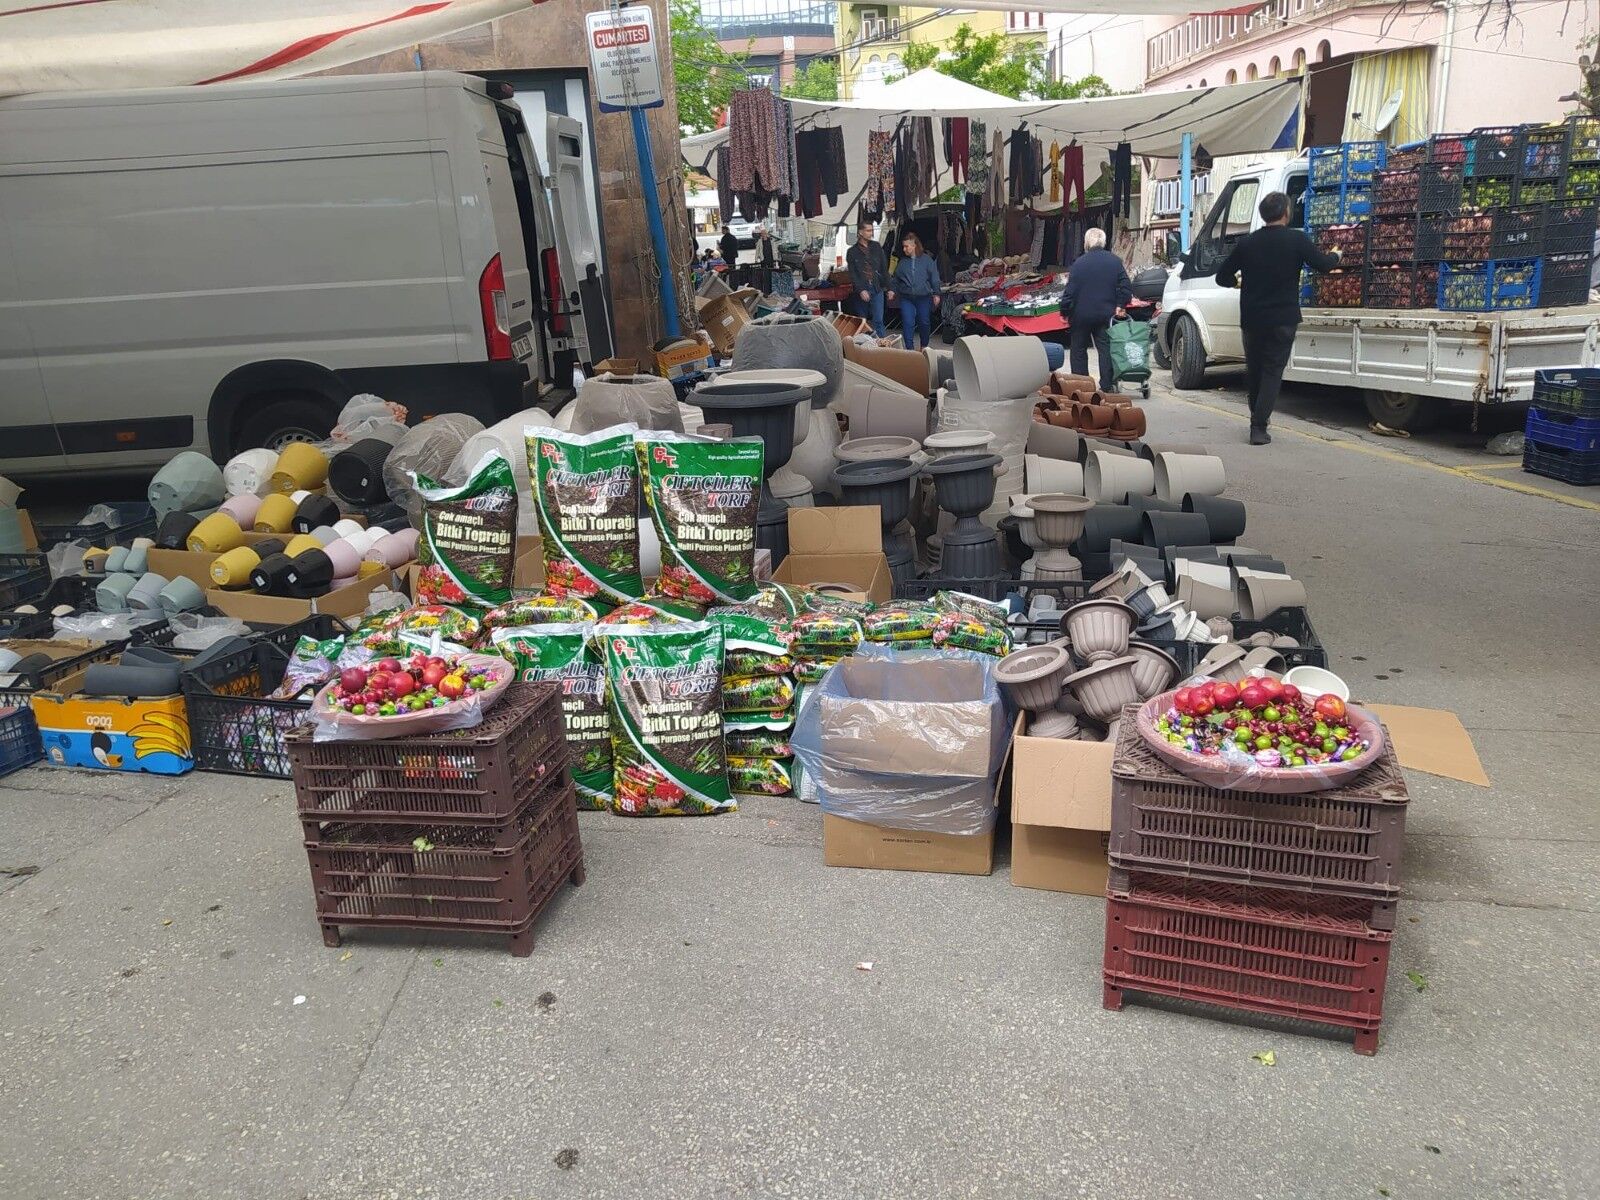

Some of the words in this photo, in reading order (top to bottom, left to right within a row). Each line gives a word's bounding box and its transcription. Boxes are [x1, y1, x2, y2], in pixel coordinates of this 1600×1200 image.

[596, 26, 648, 46] CUMARTESİ
[662, 472, 752, 494] ÇİFTÇİLER
[707, 492, 752, 507] TORF
[438, 511, 454, 522] Çok
[454, 514, 484, 526] amaçlı
[561, 516, 587, 531] Bitki
[589, 514, 635, 531] Toprağı
[678, 513, 695, 524] Çok
[696, 513, 726, 525] amaçlı
[436, 523, 462, 539] Bitki
[465, 526, 511, 546] Toprağı
[578, 534, 604, 542] Purpose
[678, 526, 705, 540] Bitki
[707, 526, 753, 542] Toprağı
[451, 542, 477, 552] Purpose
[677, 542, 694, 550] Multi
[695, 543, 722, 552] Purpose
[724, 543, 742, 551] Plant
[670, 678, 717, 696] TORF
[658, 701, 692, 714] amaçlı
[565, 712, 609, 729] Toprağ
[642, 717, 670, 733] Bitki
[673, 711, 720, 730] Toprağı
[582, 732, 601, 740] Plant
[661, 734, 690, 744] Purpose
